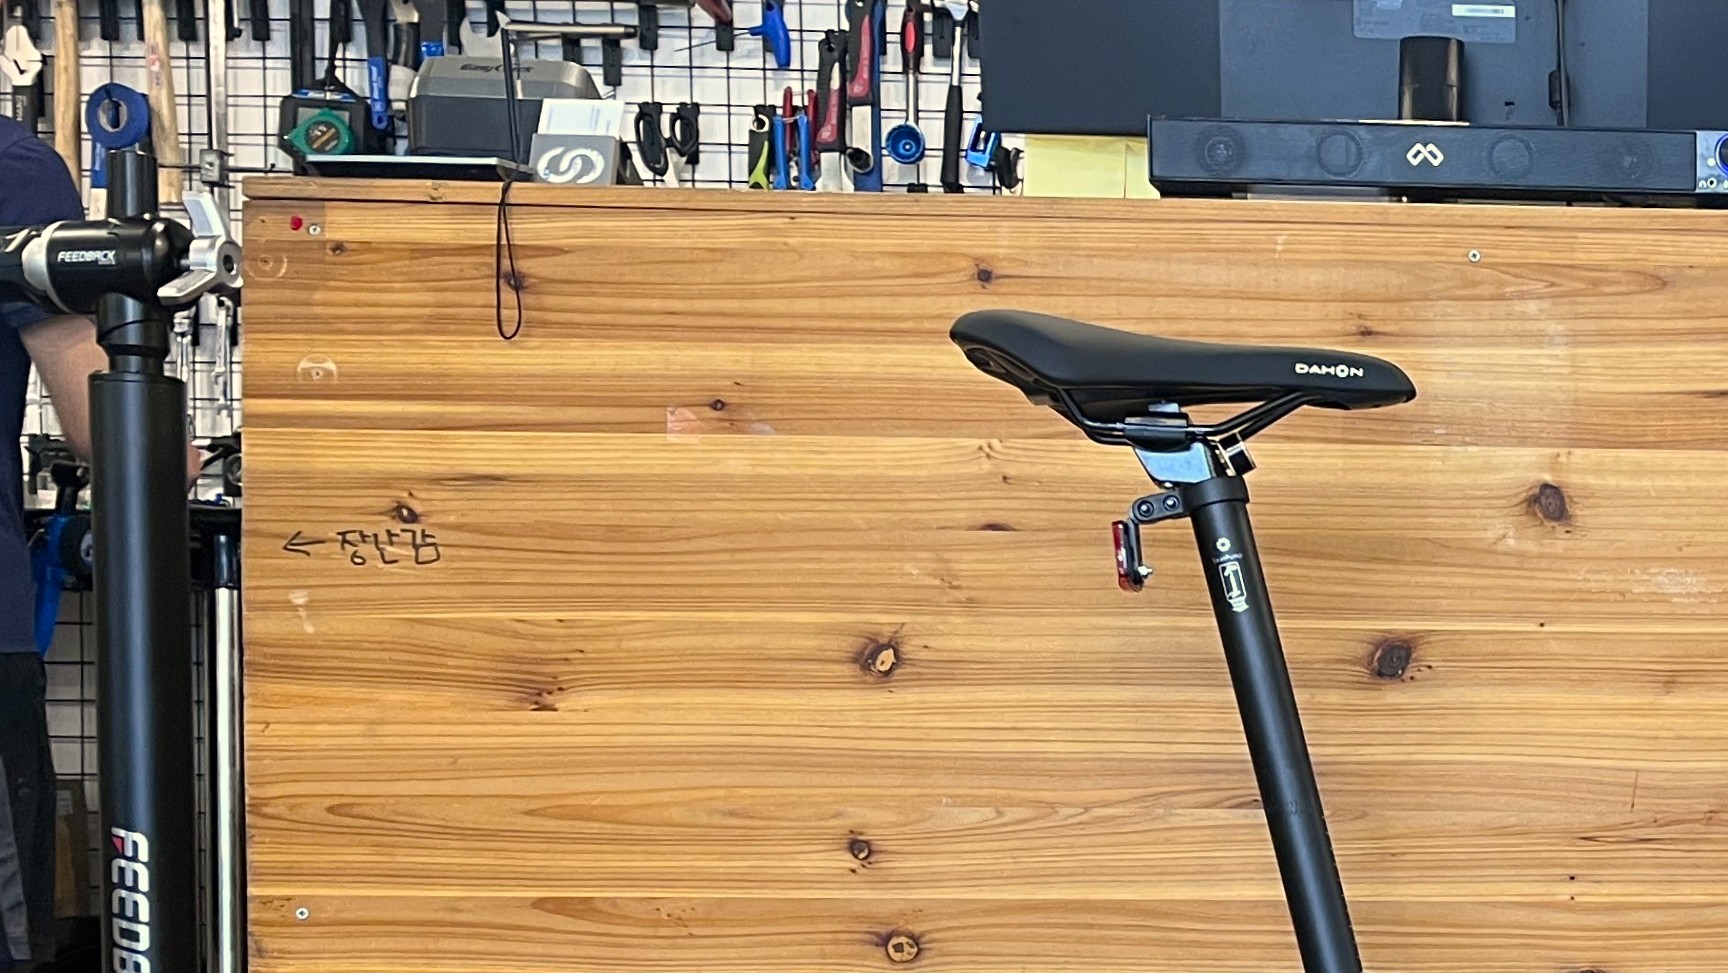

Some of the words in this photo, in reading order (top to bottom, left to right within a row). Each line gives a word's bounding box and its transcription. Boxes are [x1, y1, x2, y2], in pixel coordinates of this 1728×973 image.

[57, 250, 116, 265] FEEDBACK
[1294, 362, 1365, 378] DAHON
[336, 528, 441, 566] 장난감
